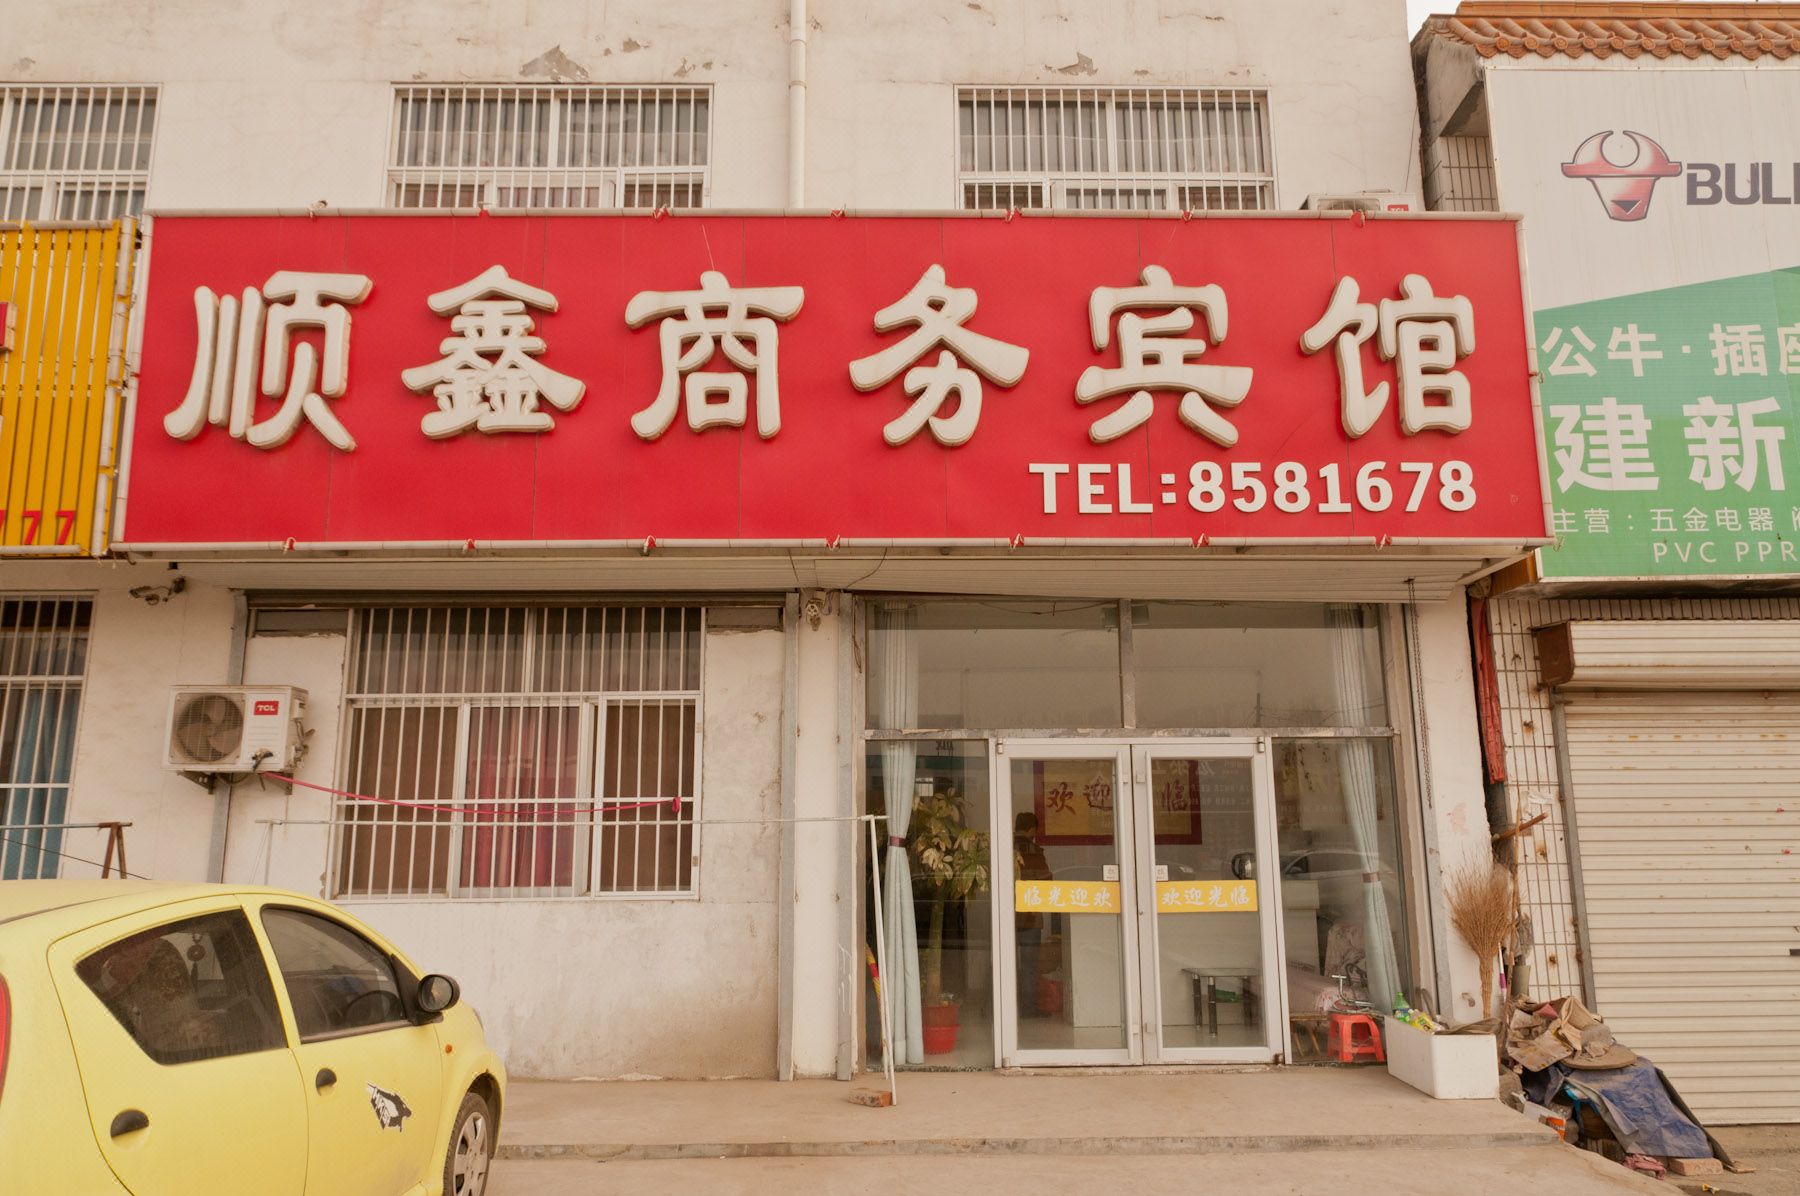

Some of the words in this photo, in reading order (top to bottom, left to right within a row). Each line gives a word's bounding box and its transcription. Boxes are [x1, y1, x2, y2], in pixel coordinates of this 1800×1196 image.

[163, 264, 1476, 450] 顺鑫商务宾馆
[1550, 396, 1786, 493] 建新
[1653, 541, 1717, 563] PVC
[1735, 540, 1798, 562] PPR
[257, 704, 276, 712] TCL
[1162, 885, 1250, 908] 欢迎光临
